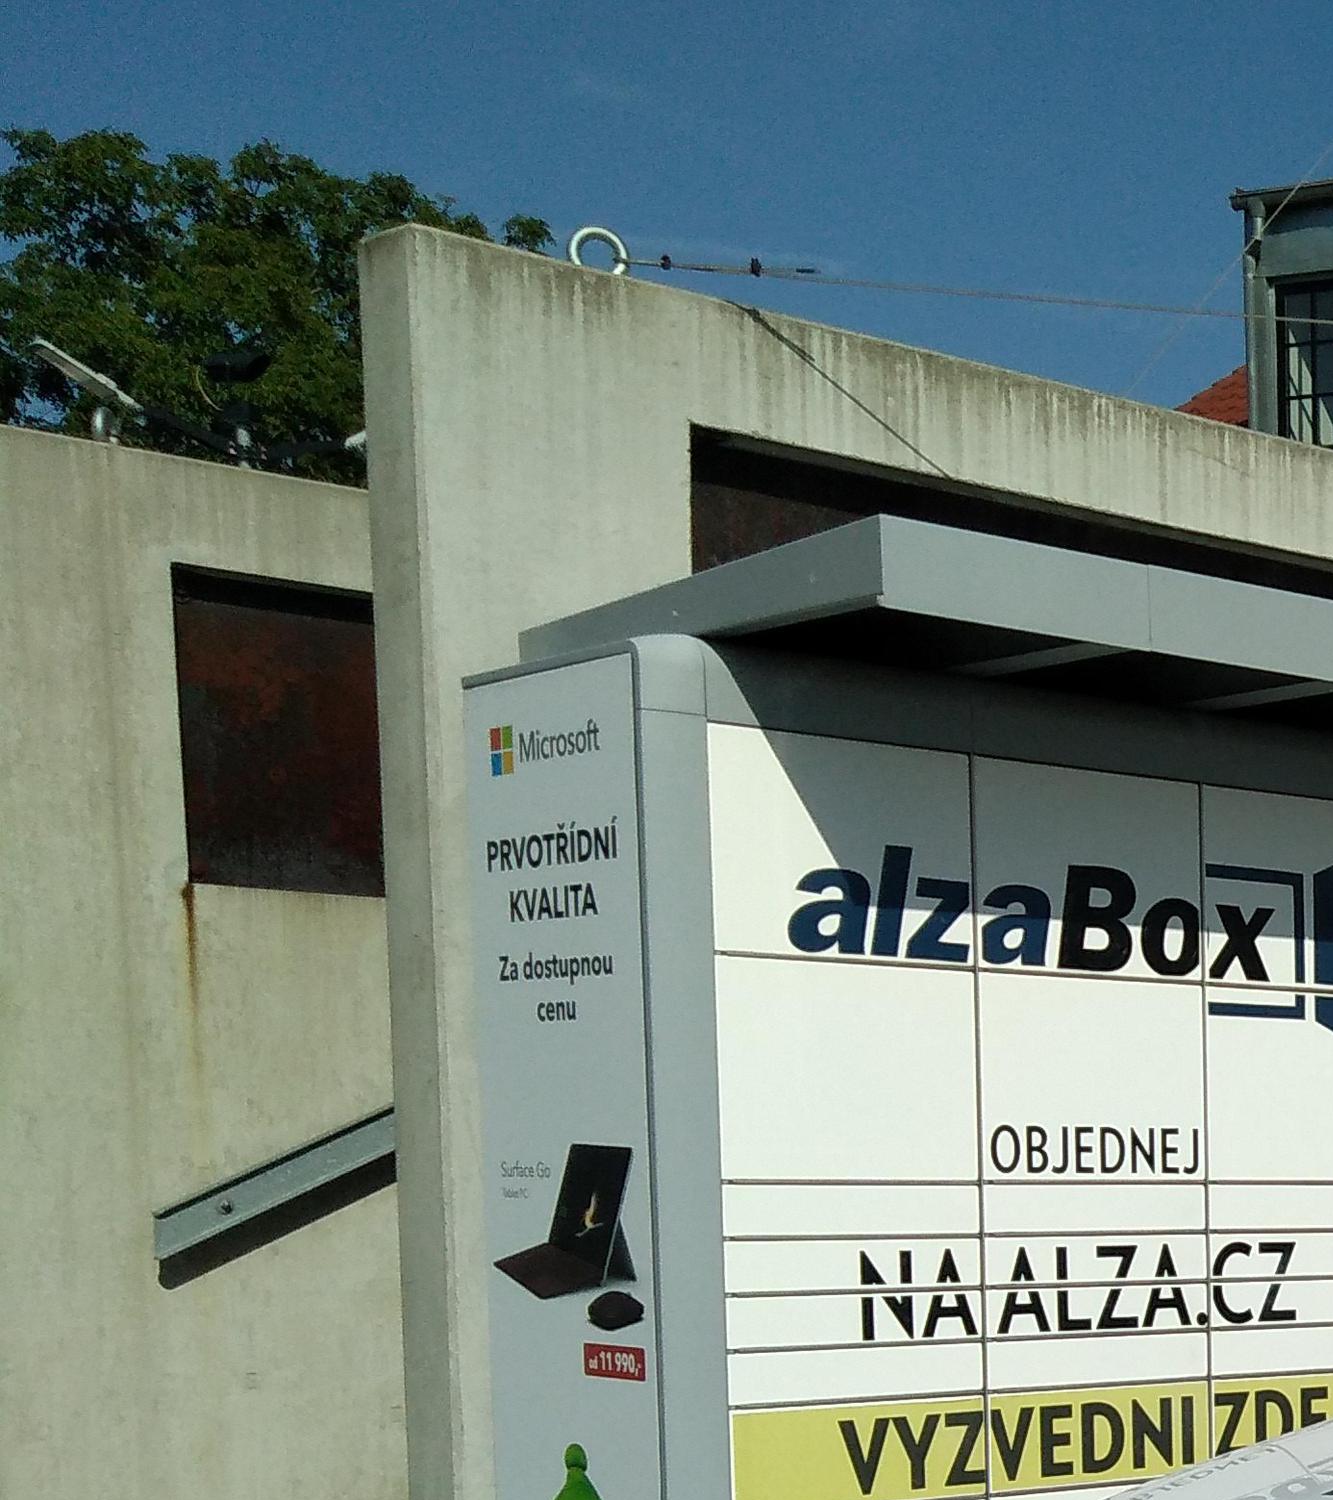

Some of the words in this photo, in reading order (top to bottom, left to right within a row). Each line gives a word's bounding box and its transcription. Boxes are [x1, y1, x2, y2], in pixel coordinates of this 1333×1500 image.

[518, 718, 600, 763] Microsoft
[486, 815, 617, 873] PRVOTŘÍDNÍ
[509, 882, 599, 923] KVALITA
[787, 844, 1276, 983] alzaBox
[499, 956, 518, 981] Za
[523, 952, 613, 985] dostupnou
[537, 1000, 577, 1022] cenu
[501, 1160, 534, 1178] Surface
[536, 1161, 550, 1178] Go
[990, 1125, 1199, 1175] OBJEDNEJ
[858, 1247, 979, 1341] NA
[997, 1242, 1297, 1333] ALZA.CZ
[588, 1355, 598, 1370] od
[838, 1396, 1195, 1495] VYZVEDNI
[1213, 1386, 1329, 1458] ZDE
